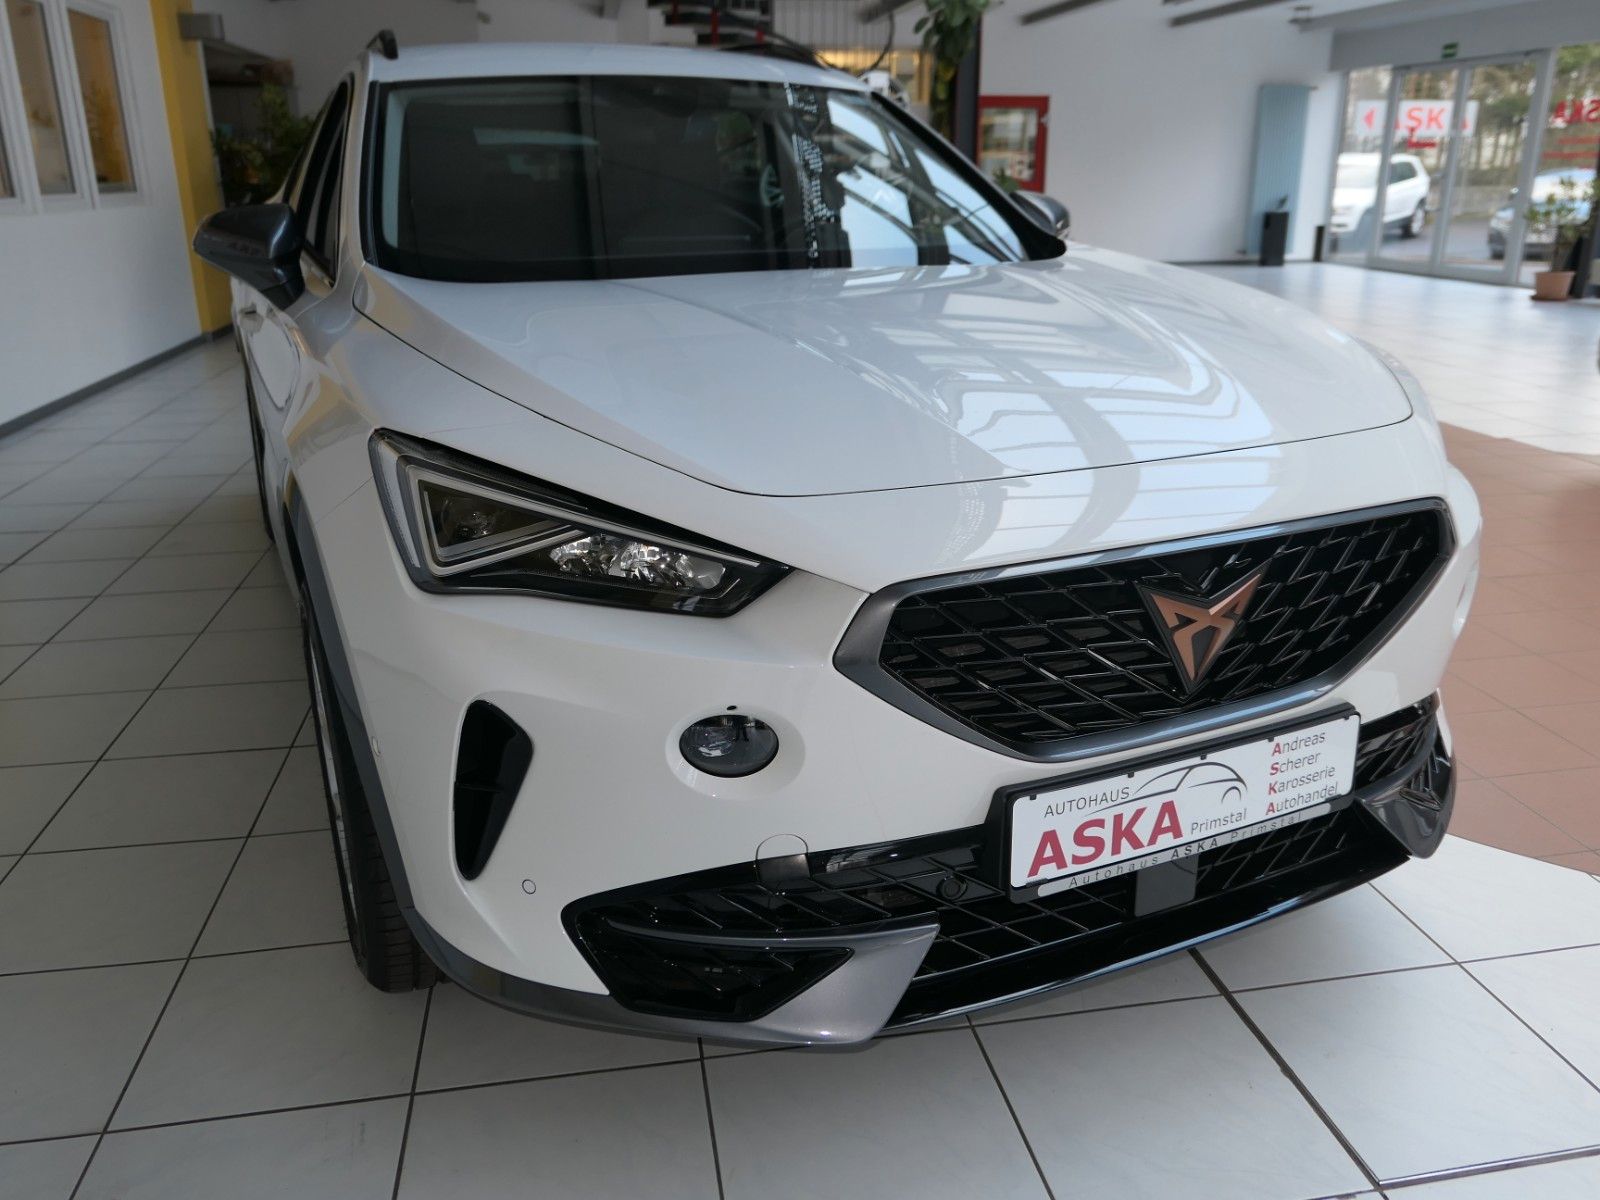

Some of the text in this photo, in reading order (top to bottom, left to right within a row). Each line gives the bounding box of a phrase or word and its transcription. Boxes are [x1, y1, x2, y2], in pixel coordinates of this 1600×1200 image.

[1271, 731, 1326, 757] Andreas
[1269, 751, 1321, 776] Scherer
[1267, 765, 1336, 796] Karosserie
[1043, 786, 1131, 818] AUTOHAUS
[1265, 782, 1338, 816] Autohandel
[1190, 808, 1248, 835] Primstal
[1026, 800, 1184, 878] ASKA
[1068, 812, 1302, 889] Autohaus ASKA Primstal
